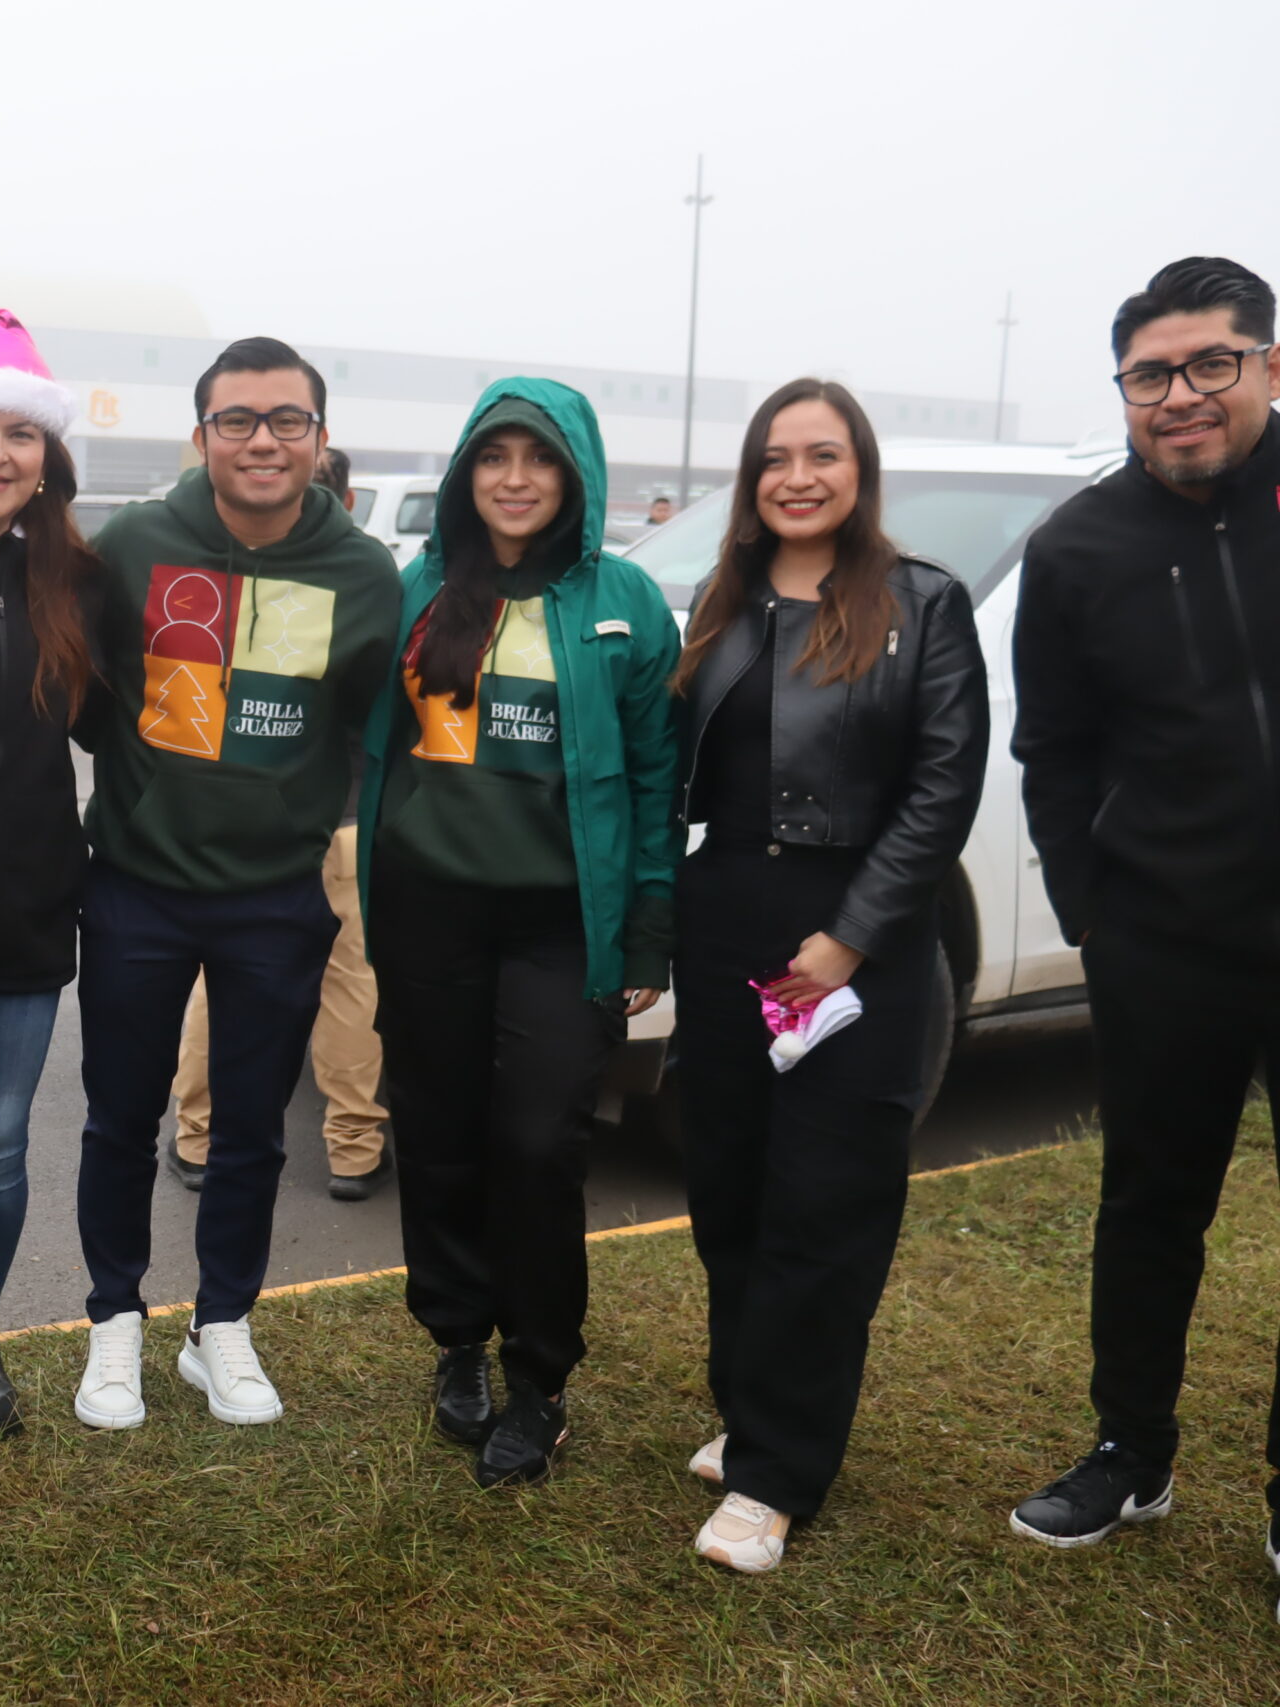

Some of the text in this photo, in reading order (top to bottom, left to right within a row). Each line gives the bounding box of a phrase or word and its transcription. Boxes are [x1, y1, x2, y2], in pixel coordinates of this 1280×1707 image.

[240, 698, 304, 719] BRILLA
[490, 702, 556, 725] BRILLA
[234, 716, 304, 737] JUÁREZ
[487, 720, 557, 743] JUÁREZ
